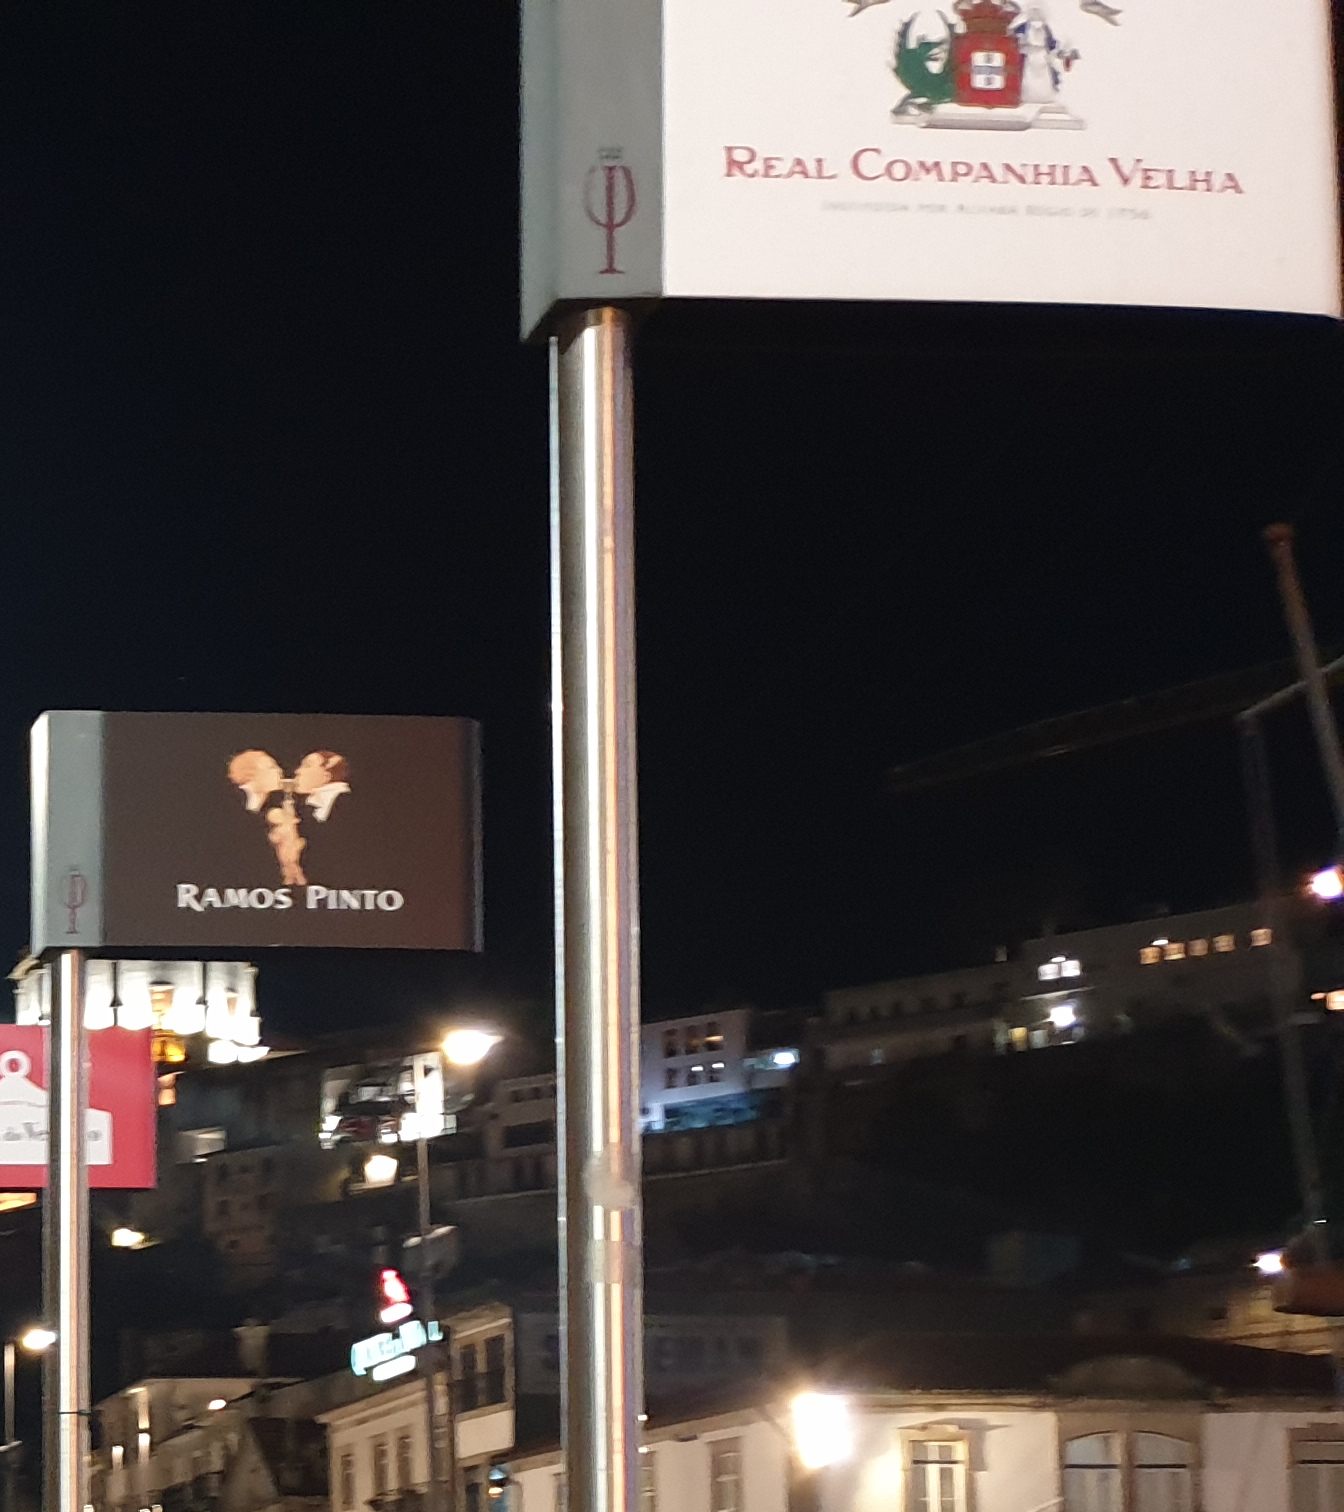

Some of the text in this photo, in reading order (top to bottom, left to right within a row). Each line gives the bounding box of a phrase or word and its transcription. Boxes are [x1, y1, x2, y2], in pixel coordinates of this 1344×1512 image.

[723, 145, 1245, 194] REAL COMPANHIA VELHA
[176, 883, 404, 912] RAMOS PINTO
